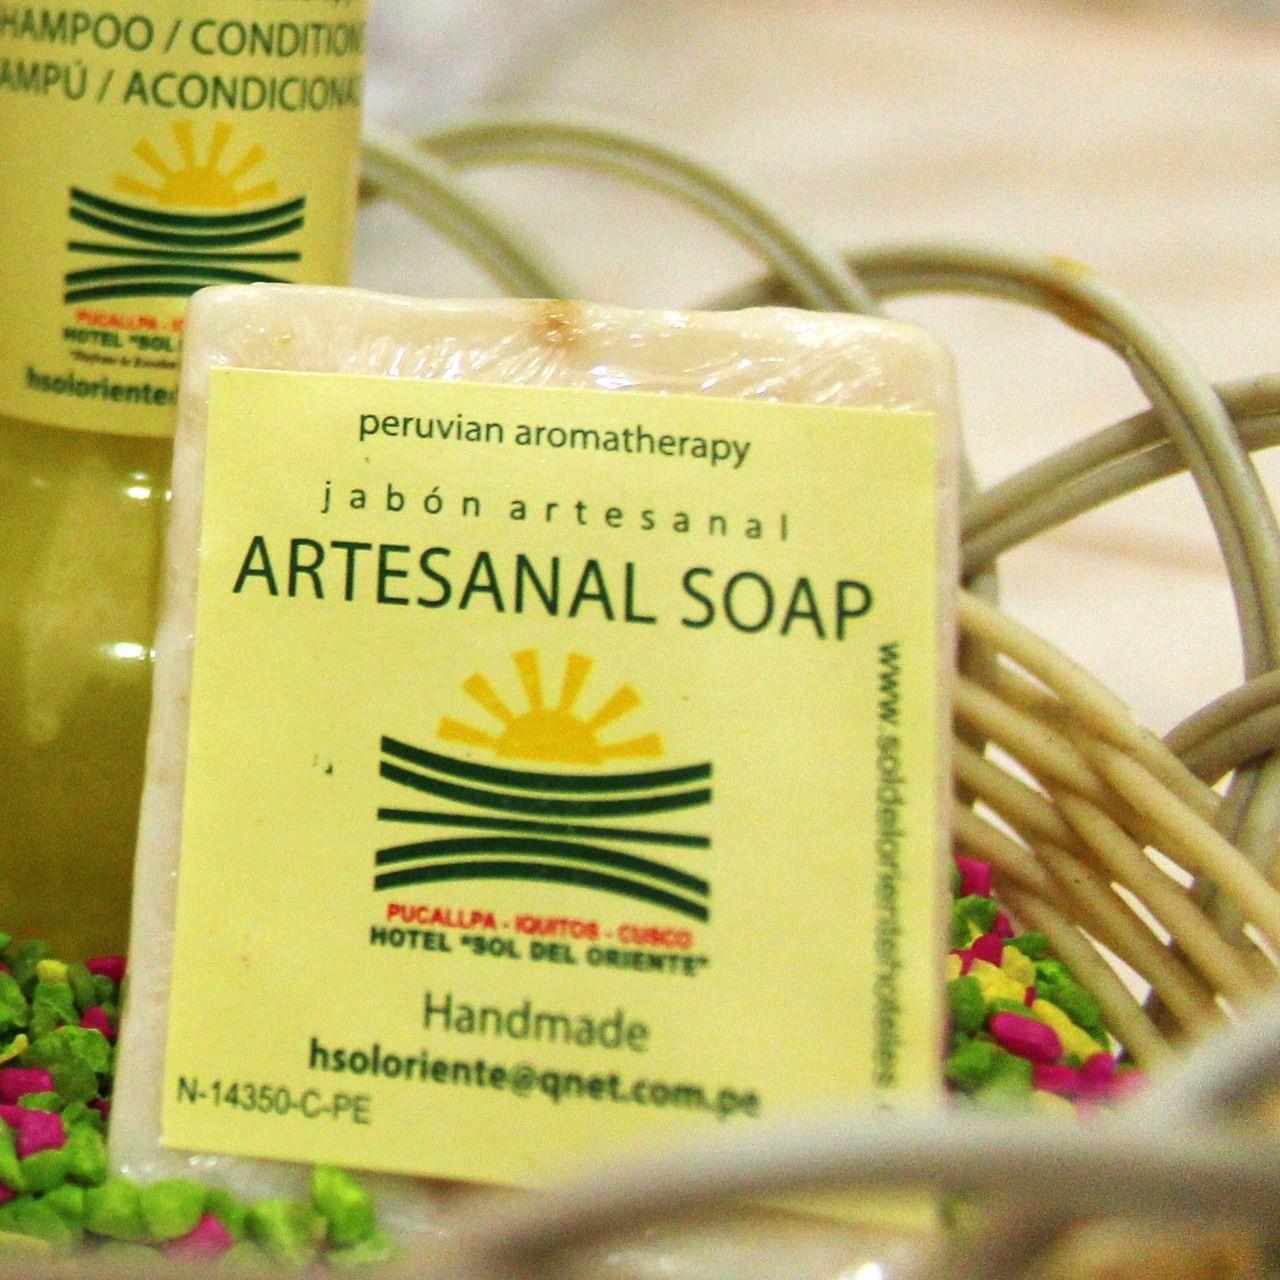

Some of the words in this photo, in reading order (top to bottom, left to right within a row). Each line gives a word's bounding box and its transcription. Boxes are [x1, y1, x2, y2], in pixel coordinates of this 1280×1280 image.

[163, 20, 181, 53] /
[96, 70, 114, 103] /
[358, 409, 504, 444] peruvian
[514, 420, 752, 468] aromatherapy
[321, 481, 481, 519] jabón
[511, 496, 789, 542] artesanal
[233, 535, 656, 625] ARTESANAL
[681, 566, 874, 641] SOAP
[370, 926, 451, 952] HOTEL
[530, 941, 576, 965] DEL
[387, 903, 496, 931] PUCALLPA
[515, 915, 599, 941] IQUITOS
[617, 924, 693, 949] CUSCO
[424, 991, 650, 1053] Handmade
[176, 1076, 373, 1125] N-14350-C-PE
[309, 1038, 761, 1120] hsoloriente@qnet.com.pe
